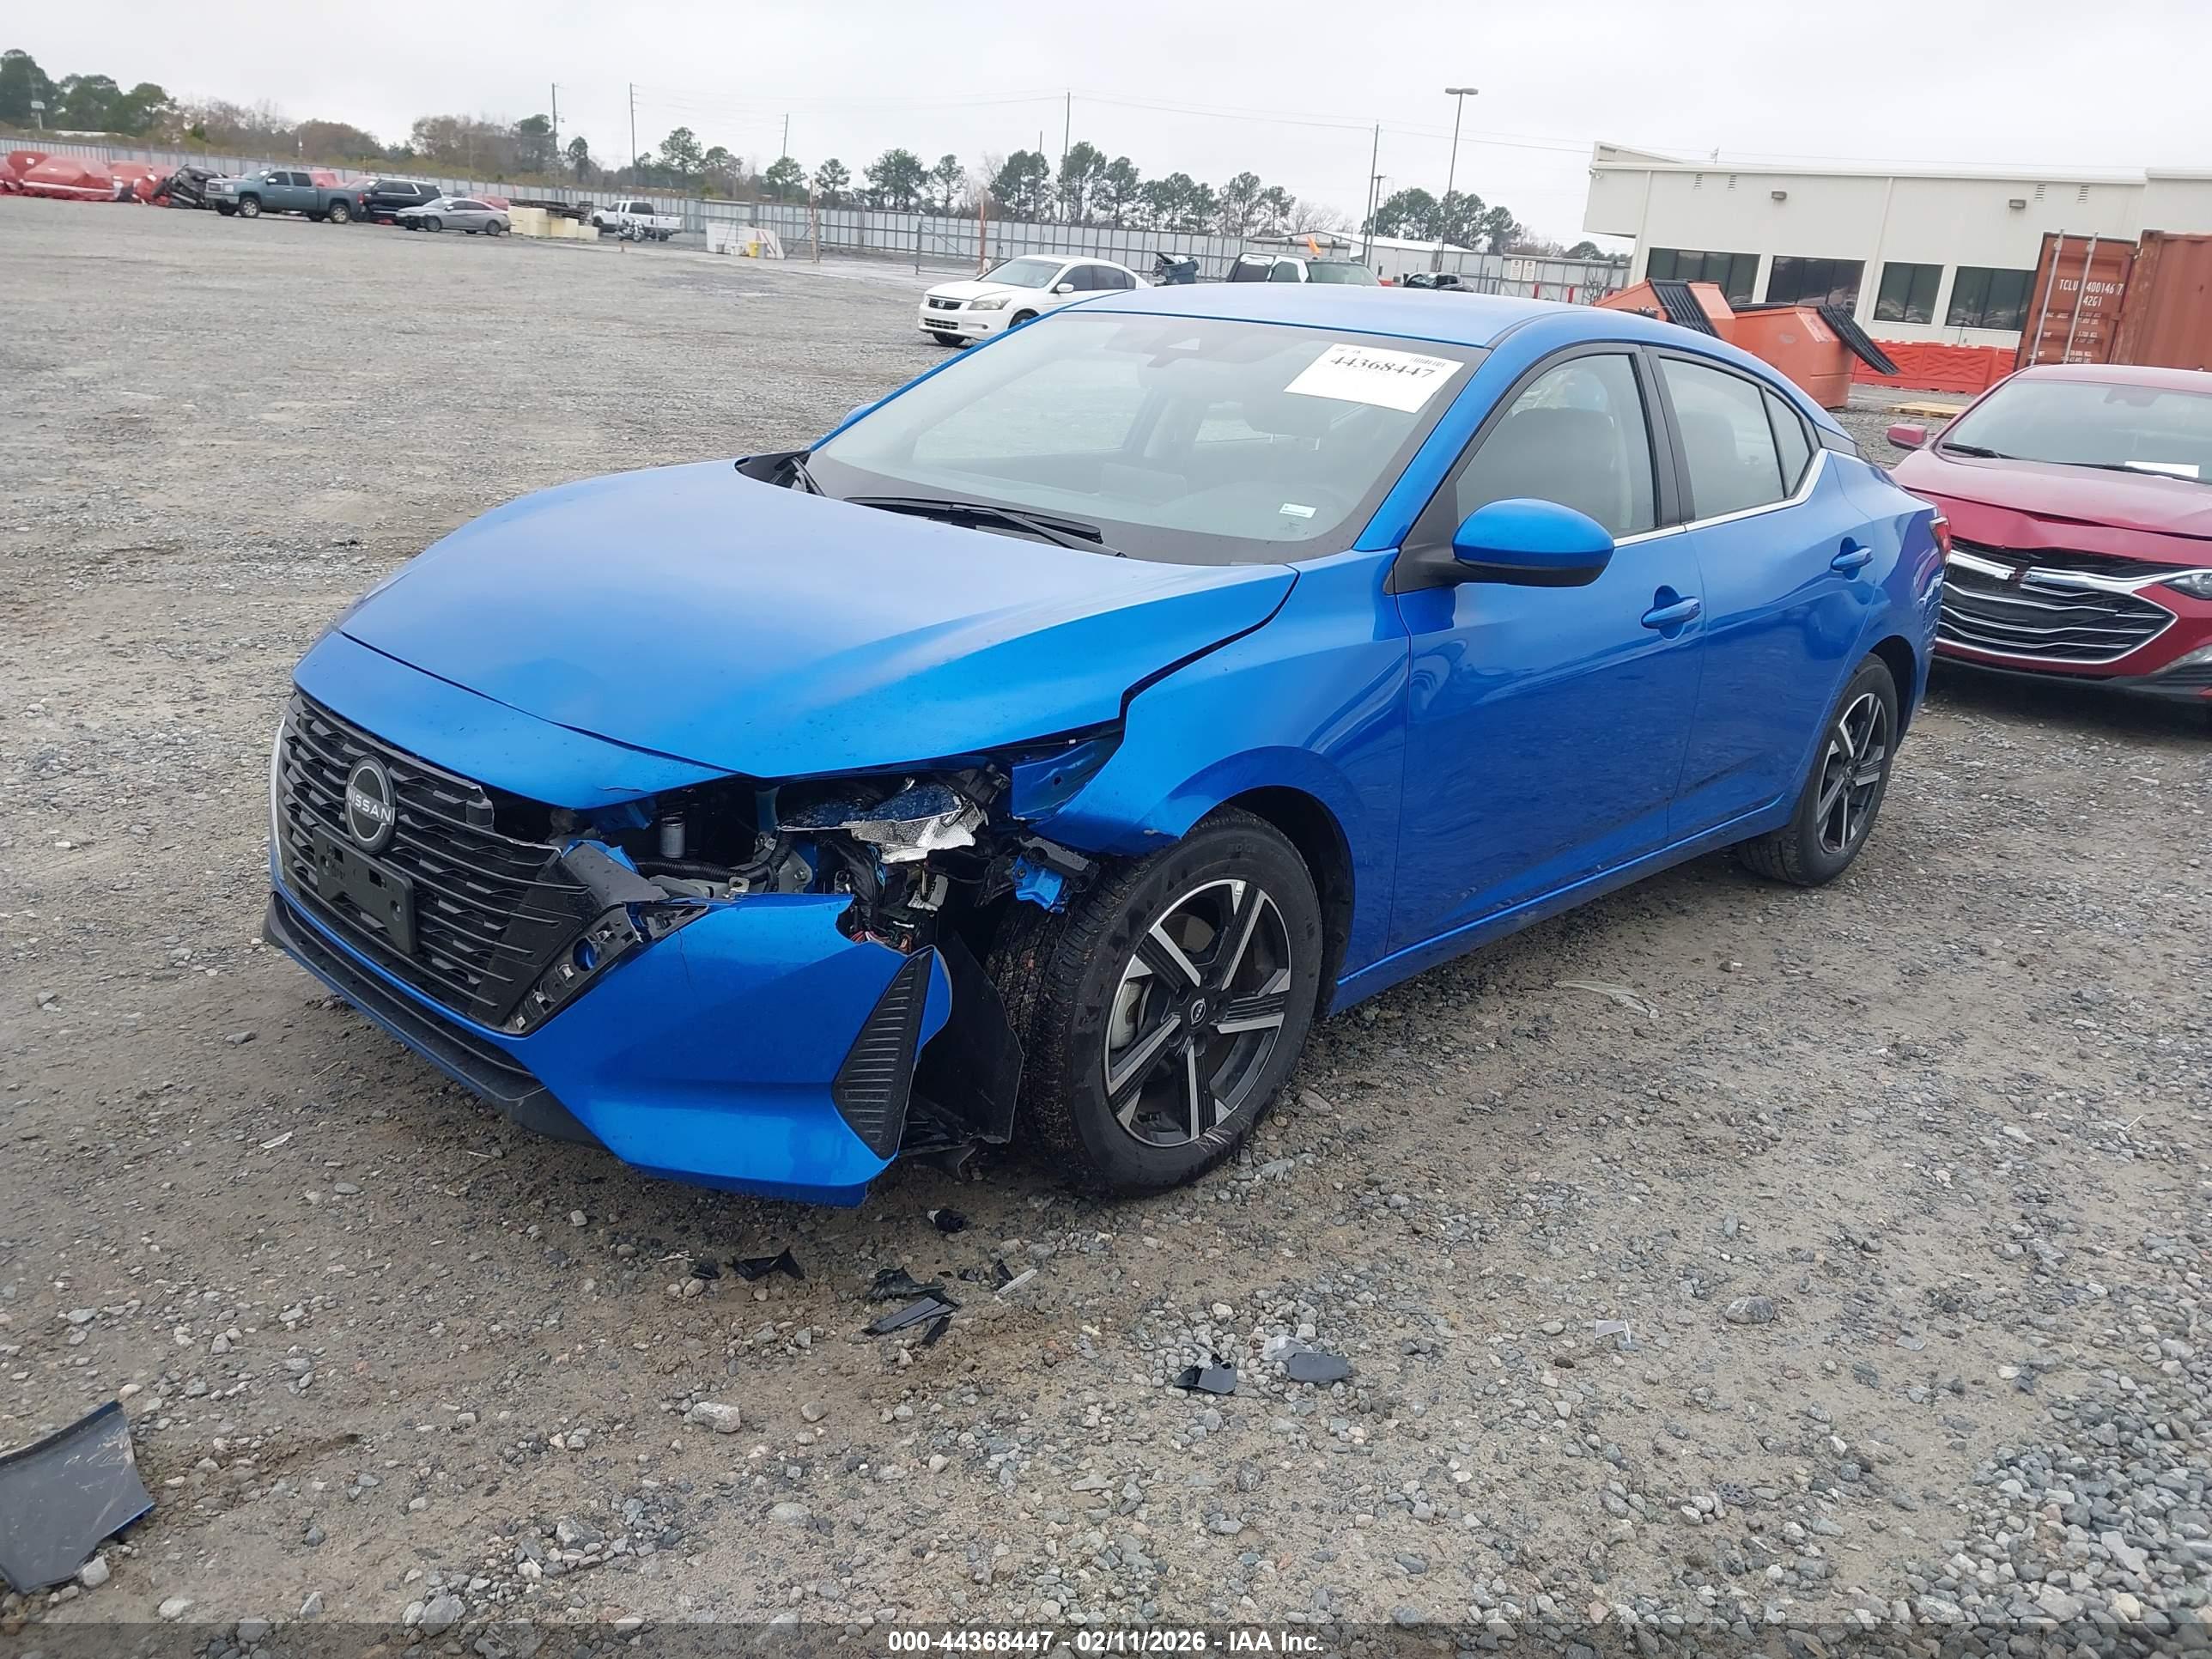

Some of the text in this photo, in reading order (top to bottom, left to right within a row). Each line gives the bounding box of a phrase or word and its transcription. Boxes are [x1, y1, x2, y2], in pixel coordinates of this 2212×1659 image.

[2059, 279, 2079, 291] TCLU
[2086, 281, 2116, 295] 400146
[2083, 295, 2103, 307] 42G1
[1330, 356, 1436, 378] 44368447
[346, 785, 392, 822] NISSAN
